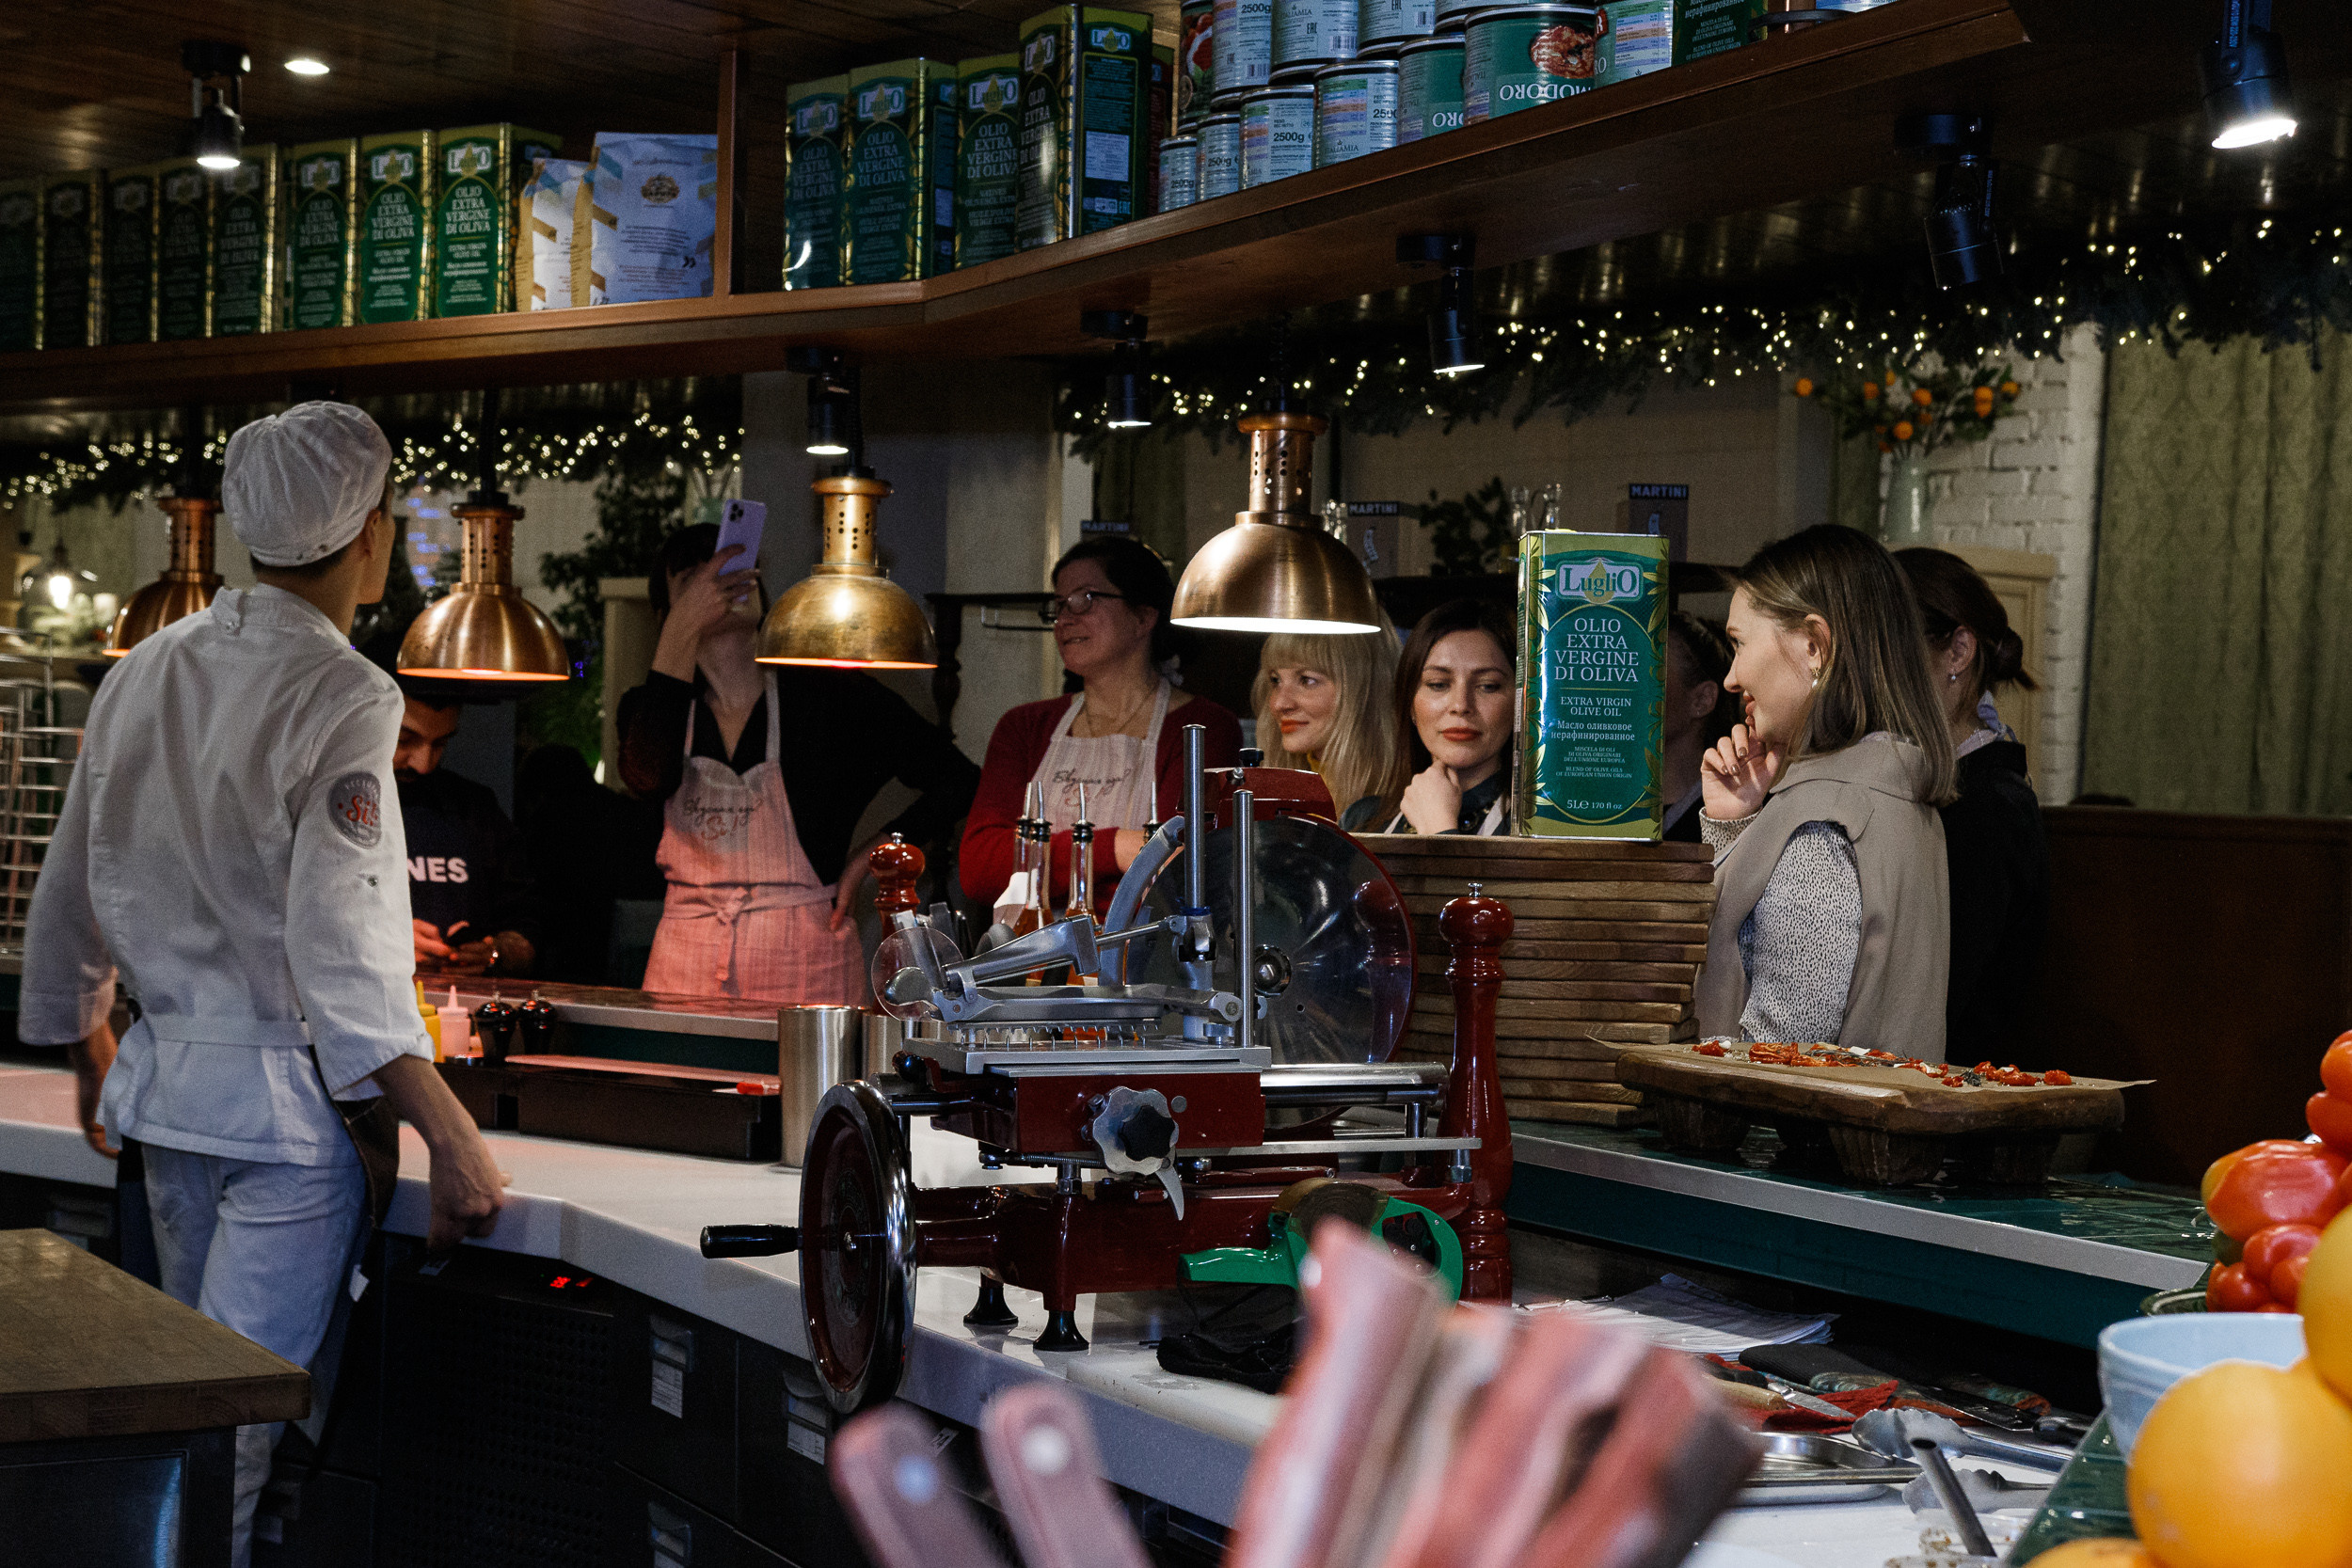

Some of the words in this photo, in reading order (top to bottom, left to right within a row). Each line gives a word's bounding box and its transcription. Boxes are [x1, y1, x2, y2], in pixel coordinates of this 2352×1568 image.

[1241, 3, 1270, 14] 2500g
[978, 122, 1009, 137] OLIO
[867, 131, 895, 146] OLIO
[975, 135, 1013, 151] EXTRA
[1274, 132, 1304, 144] 2500g
[864, 144, 898, 160] EXTRA
[857, 156, 905, 173] VERGINE
[967, 164, 980, 179] DI
[859, 174, 871, 187] DI
[873, 169, 906, 185] OLIVA
[380, 191, 406, 205] OLIO
[454, 185, 483, 199] OLIO
[377, 203, 409, 216] EXTRA
[452, 197, 485, 211] EXTRA
[371, 214, 415, 228] VERGINE
[445, 208, 491, 222] VERGINE
[384, 227, 415, 240] OLIVA
[445, 223, 457, 236] DI
[458, 221, 491, 234] OLIVA
[1631, 485, 1687, 498] MARTINI
[1349, 503, 1398, 515] MARTINI
[1574, 618, 1621, 633] OLIO
[1566, 634, 1629, 650] EXTRA
[1555, 650, 1639, 666] VERGINE
[1554, 666, 1575, 680] DI
[1581, 667, 1639, 682] OLIVA
[1561, 696, 1595, 705] EXTRA
[1596, 697, 1632, 706] VIRGIN
[1570, 706, 1601, 716] OLIVE
[1603, 707, 1622, 717] OIL
[1557, 720, 1584, 730] Масло
[1586, 721, 1632, 731] оливковое
[1550, 730, 1635, 741] нерафинированное
